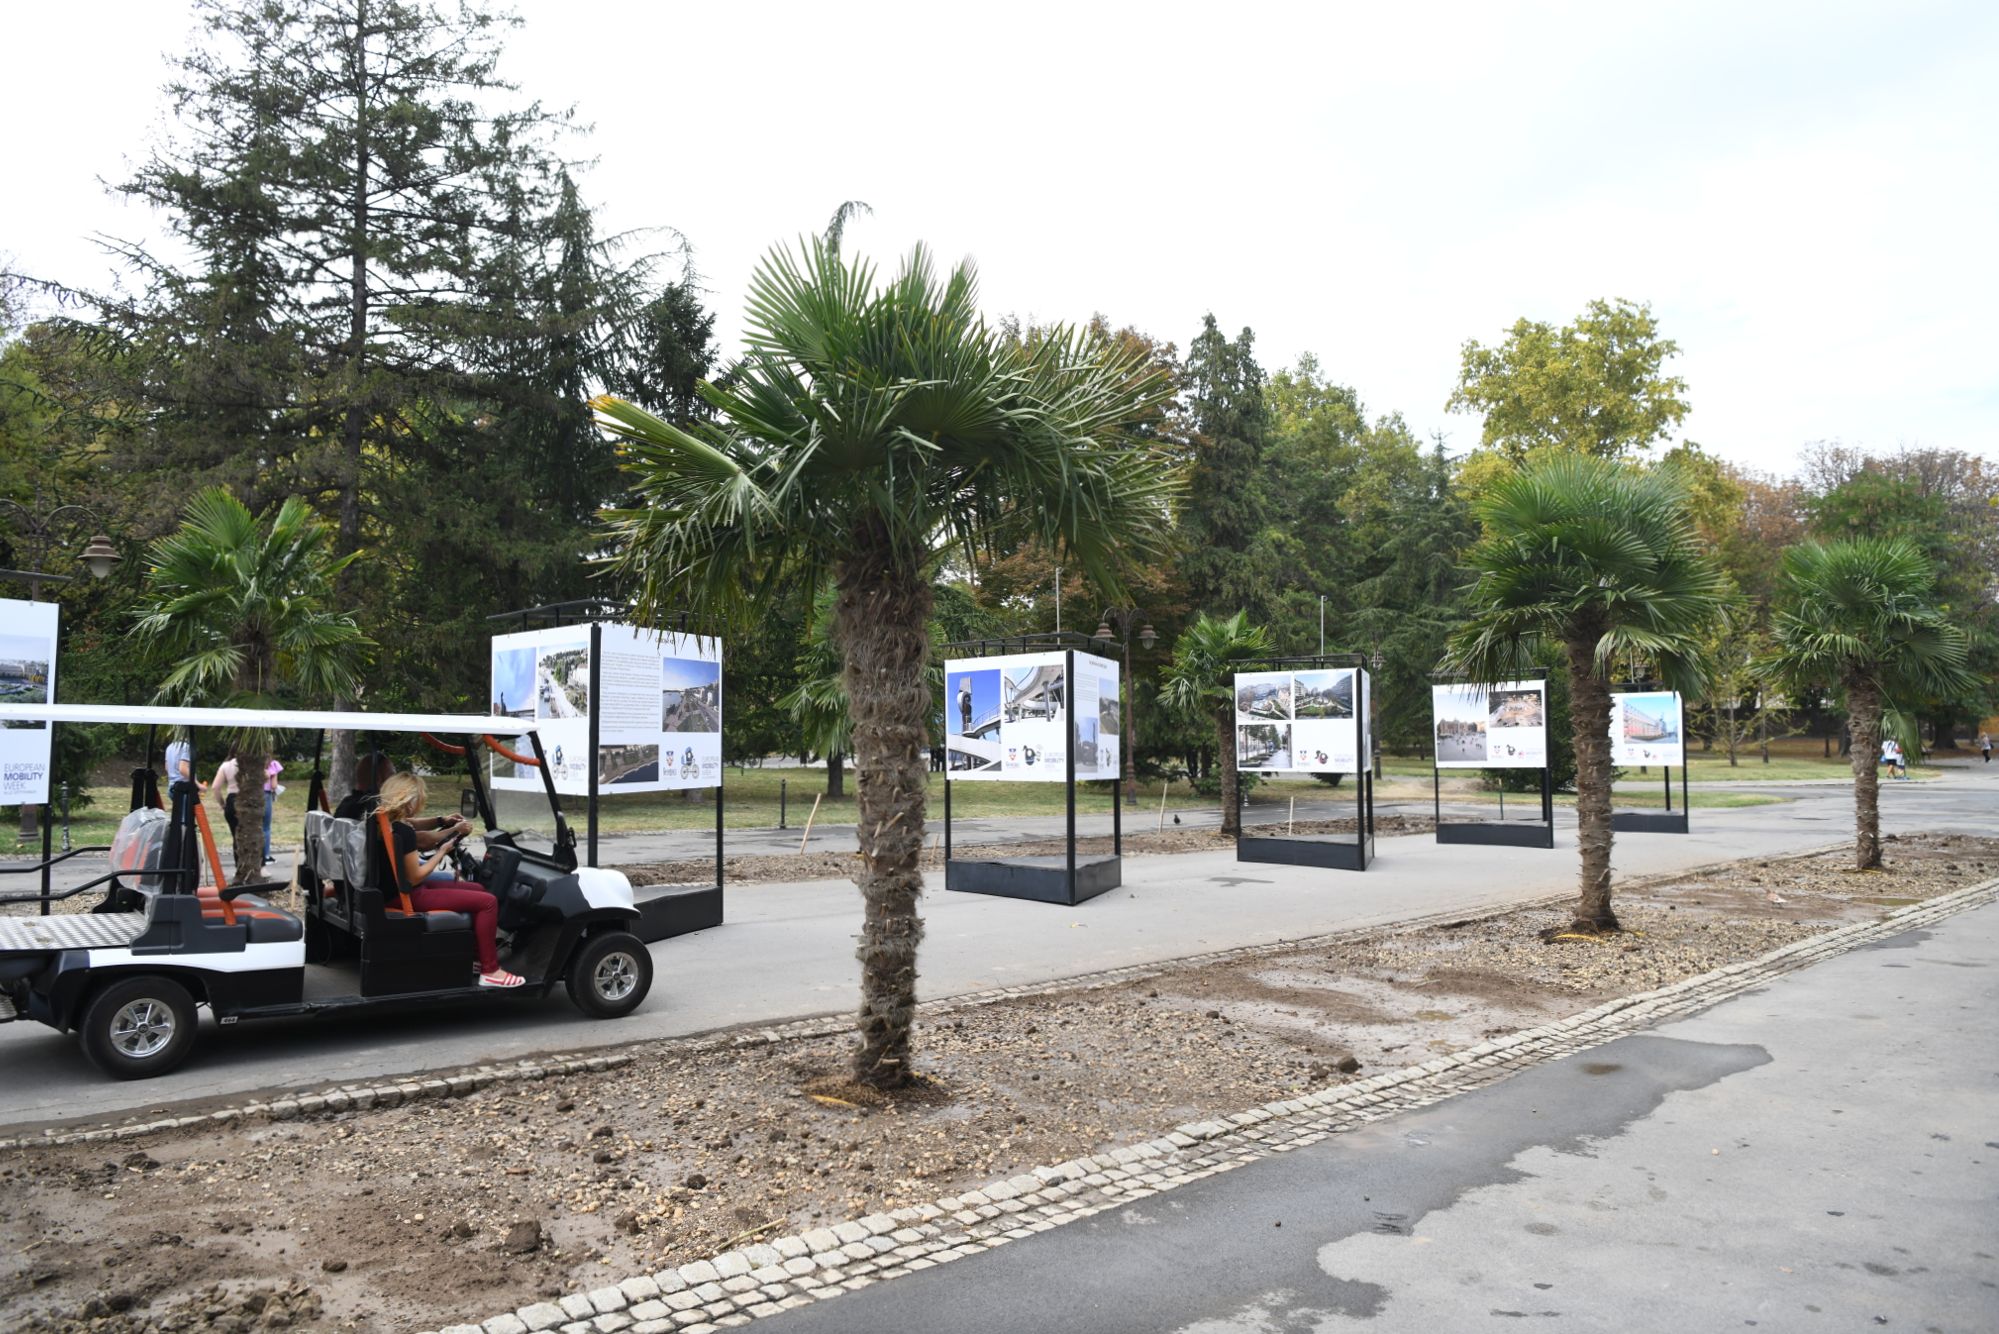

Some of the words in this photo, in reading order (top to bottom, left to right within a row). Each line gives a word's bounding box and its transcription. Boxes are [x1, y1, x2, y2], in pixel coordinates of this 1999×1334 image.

[4, 763, 46, 772] EUROPEAN
[4, 772, 44, 780] MOBILITY
[3, 781, 26, 790] WEEK
